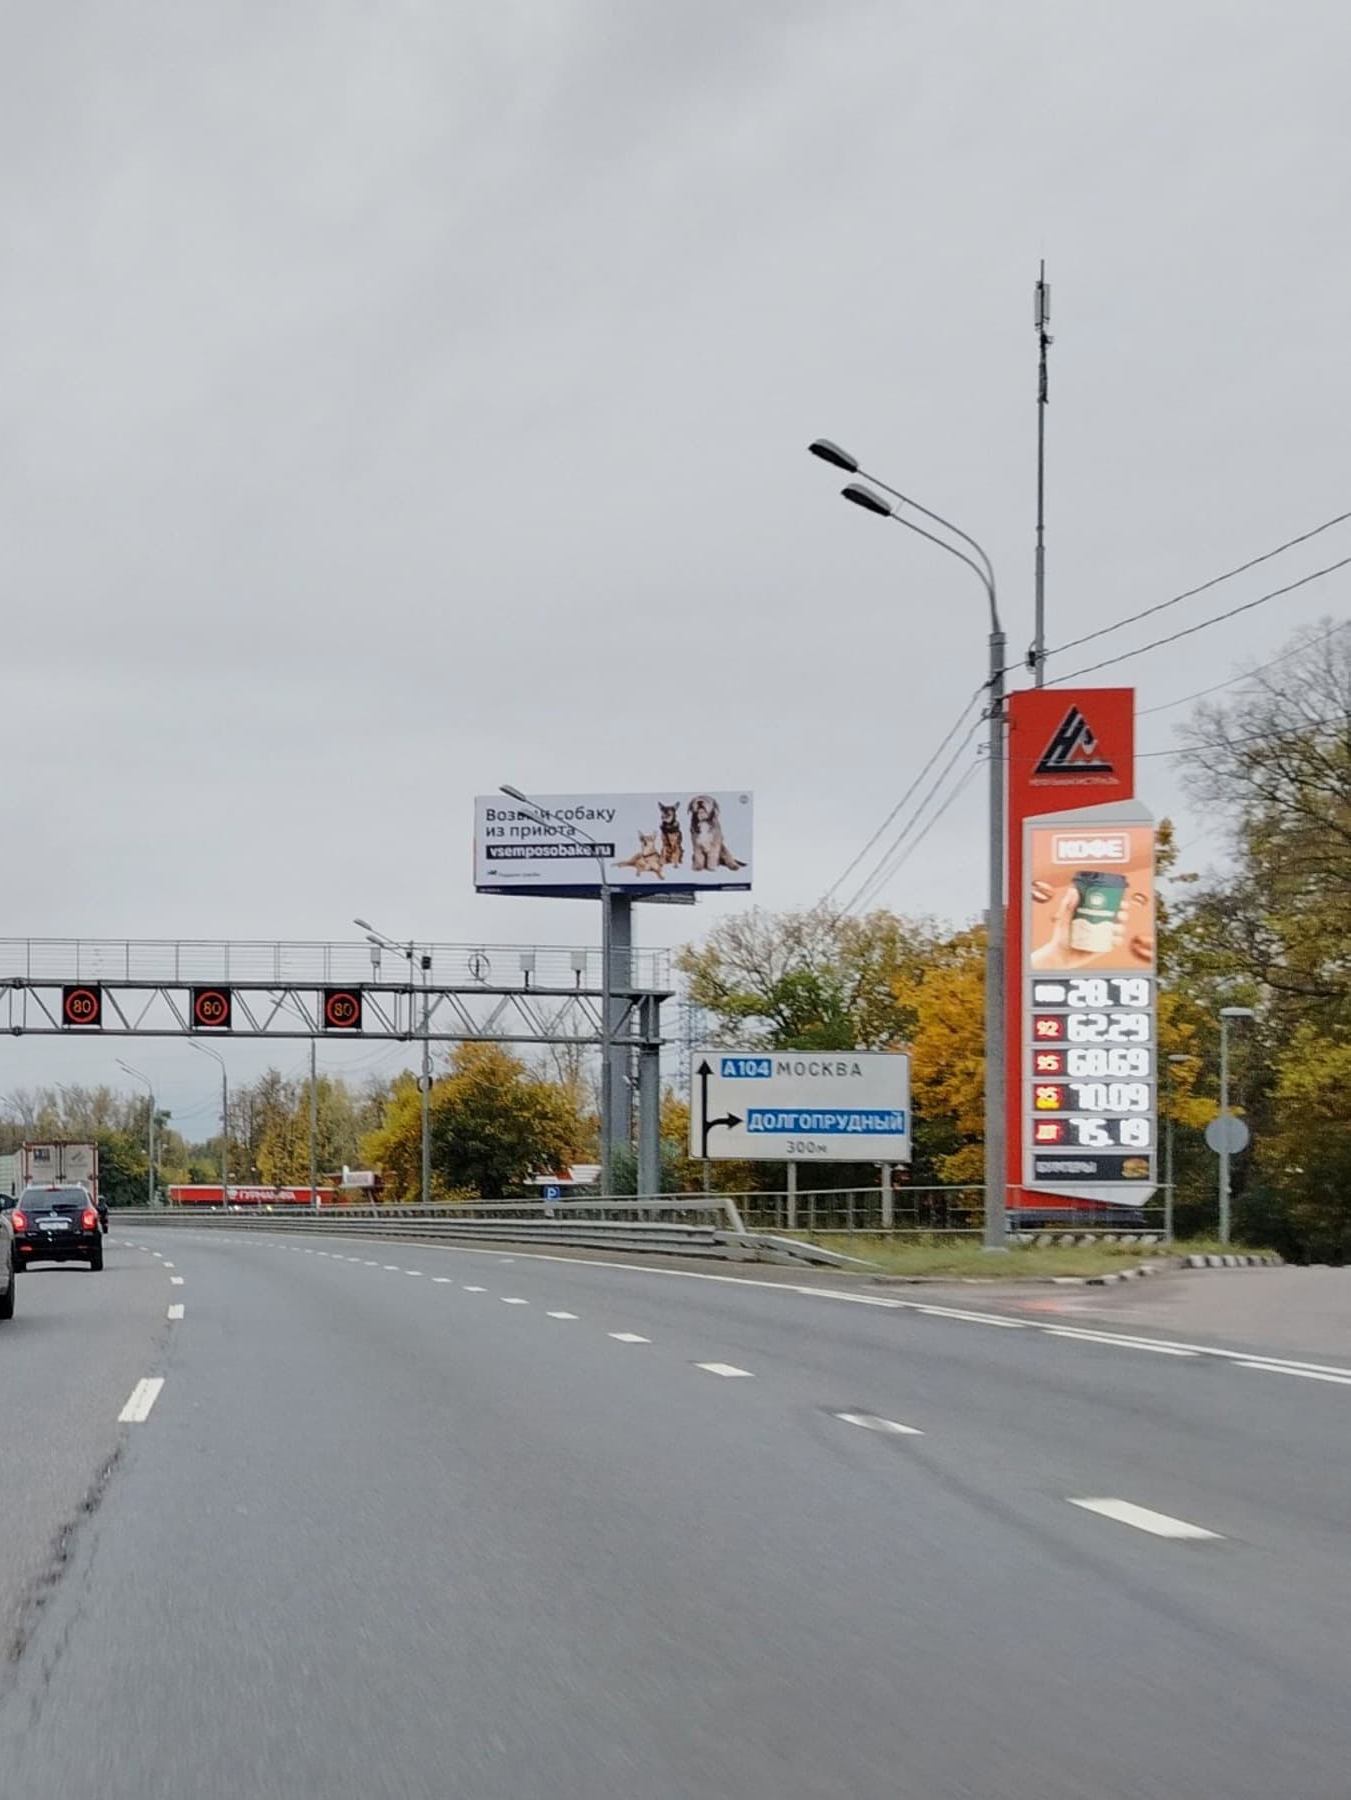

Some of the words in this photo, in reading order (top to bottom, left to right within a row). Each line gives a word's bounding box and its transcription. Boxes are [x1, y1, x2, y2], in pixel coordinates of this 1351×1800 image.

[554, 805, 616, 823] собаку
[486, 826, 505, 838] из
[510, 825, 576, 840] приюта
[1058, 839, 1122, 858] КОФЕ
[1067, 979, 1149, 1007] 28.79
[73, 1000, 91, 1013] 80
[203, 1002, 222, 1015] 80
[334, 1003, 353, 1017] 80
[1036, 1021, 1059, 1036] 92
[1067, 1014, 1149, 1042] 62.29
[776, 1061, 862, 1077] МОСКВА
[1036, 1055, 1060, 1070] 95
[749, 1111, 903, 1131] ДОЛГОПРУДНЫЙ
